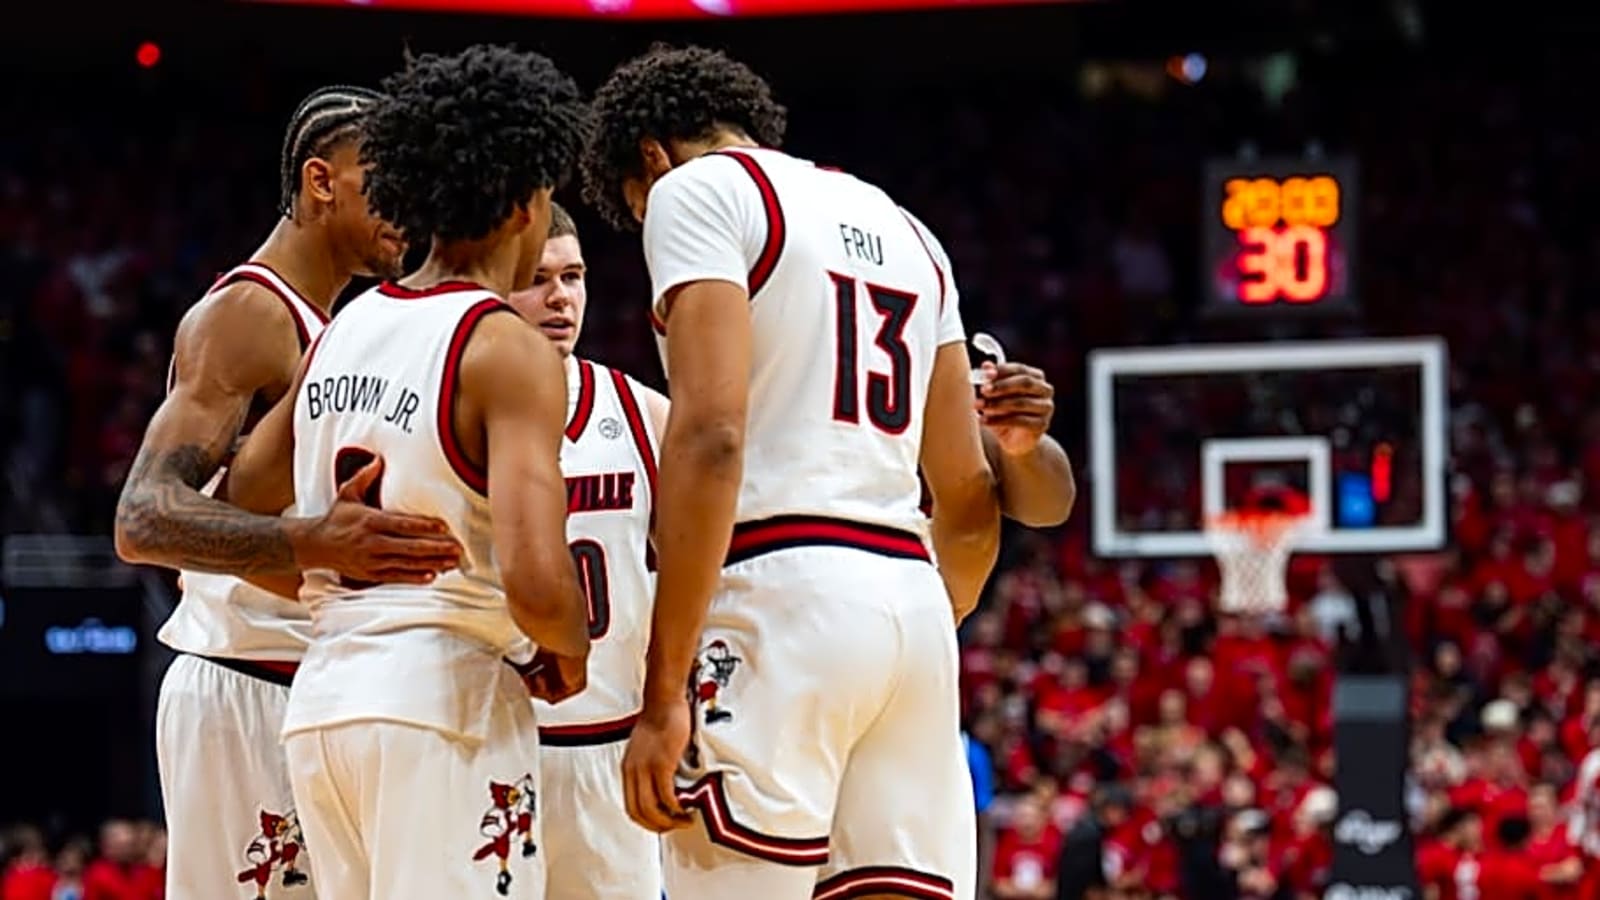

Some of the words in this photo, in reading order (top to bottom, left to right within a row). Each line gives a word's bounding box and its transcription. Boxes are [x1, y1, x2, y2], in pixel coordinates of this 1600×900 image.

[838, 223, 884, 266] FRU
[1237, 225, 1327, 302] 30
[826, 269, 919, 436] 13
[307, 374, 388, 420] BROWN
[384, 387, 420, 434] JR.
